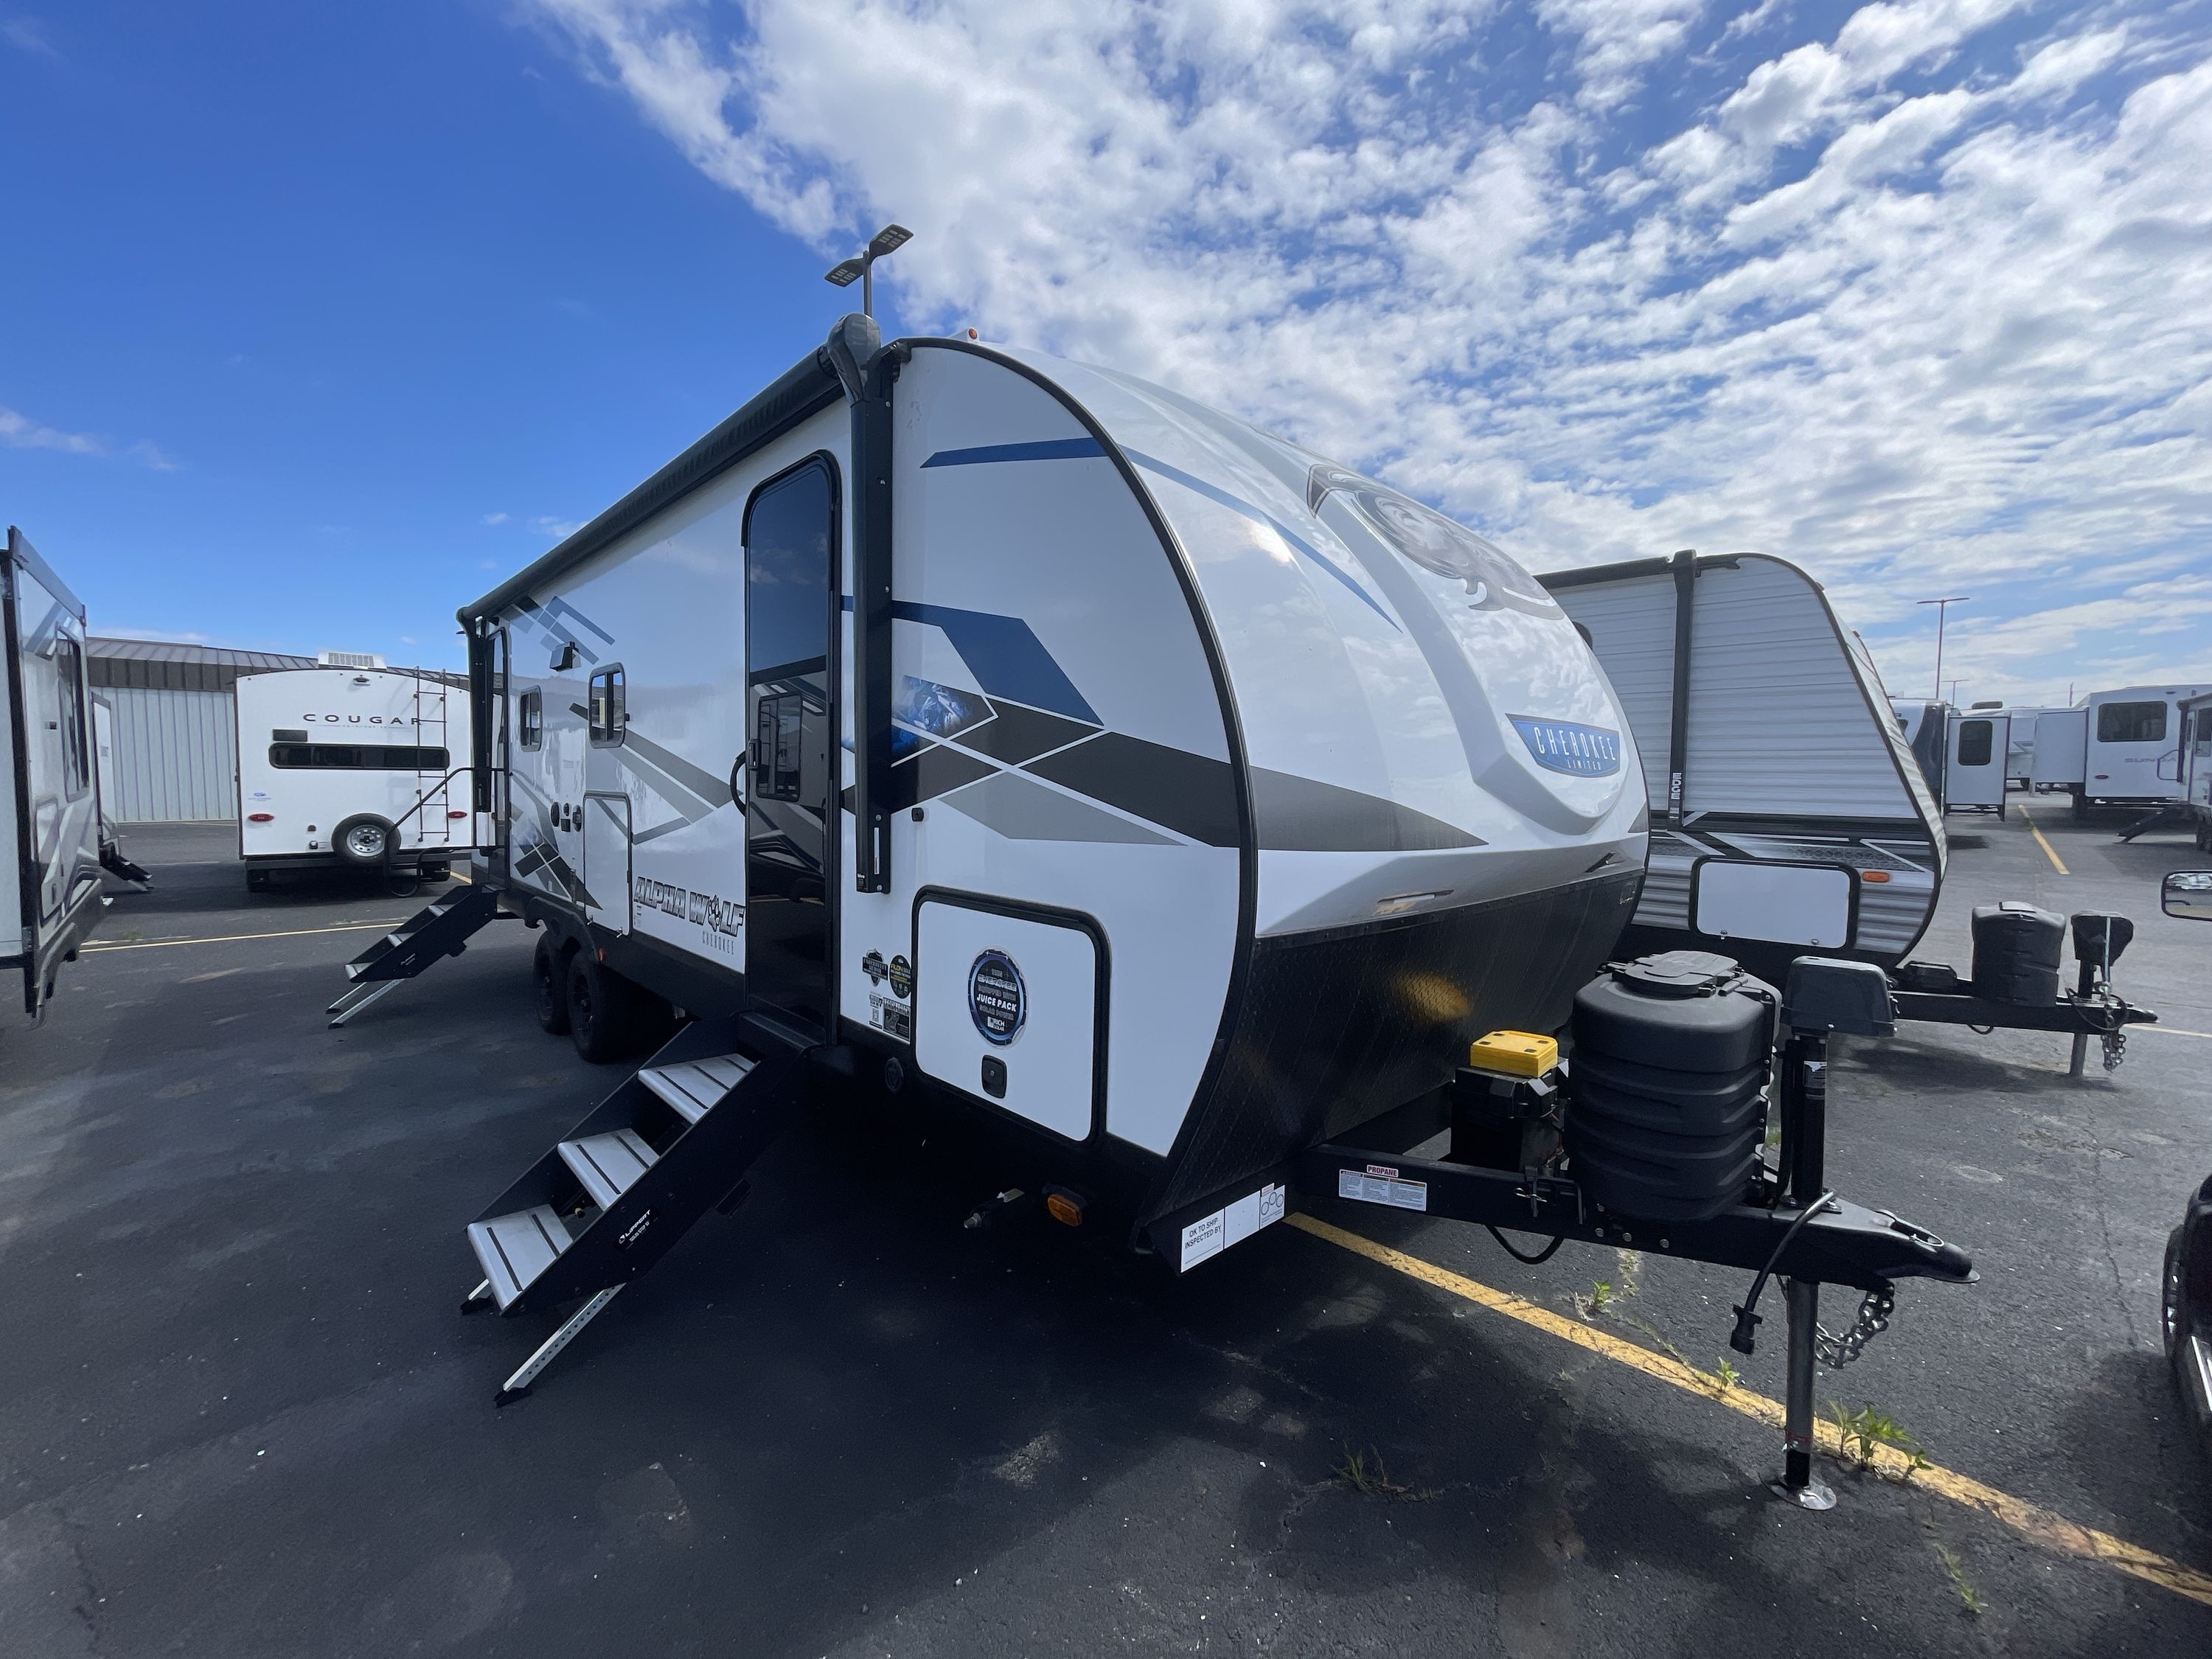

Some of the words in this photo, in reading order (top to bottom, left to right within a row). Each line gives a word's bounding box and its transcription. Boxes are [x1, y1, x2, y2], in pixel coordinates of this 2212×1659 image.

[303, 714, 422, 725] COUGAR
[1534, 727, 1616, 760] CHEROKEE
[1567, 759, 1601, 771] LIMITED
[1671, 773, 1682, 800] EDGE
[633, 876, 686, 919] ALPHA
[703, 931, 734, 955] CHEROKEE
[977, 974, 1017, 992] CHEROKEE
[977, 993, 996, 1007] JUICE
[997, 999, 1017, 1012] PACK
[1368, 1166, 1397, 1177] PROPANE
[1184, 1231, 1214, 1250] INSPECTED
[1214, 1225, 1222, 1234] BY
[1189, 1228, 1197, 1238] OK
[1198, 1224, 1206, 1233] TO
[1206, 1217, 1218, 1229] SHIP
